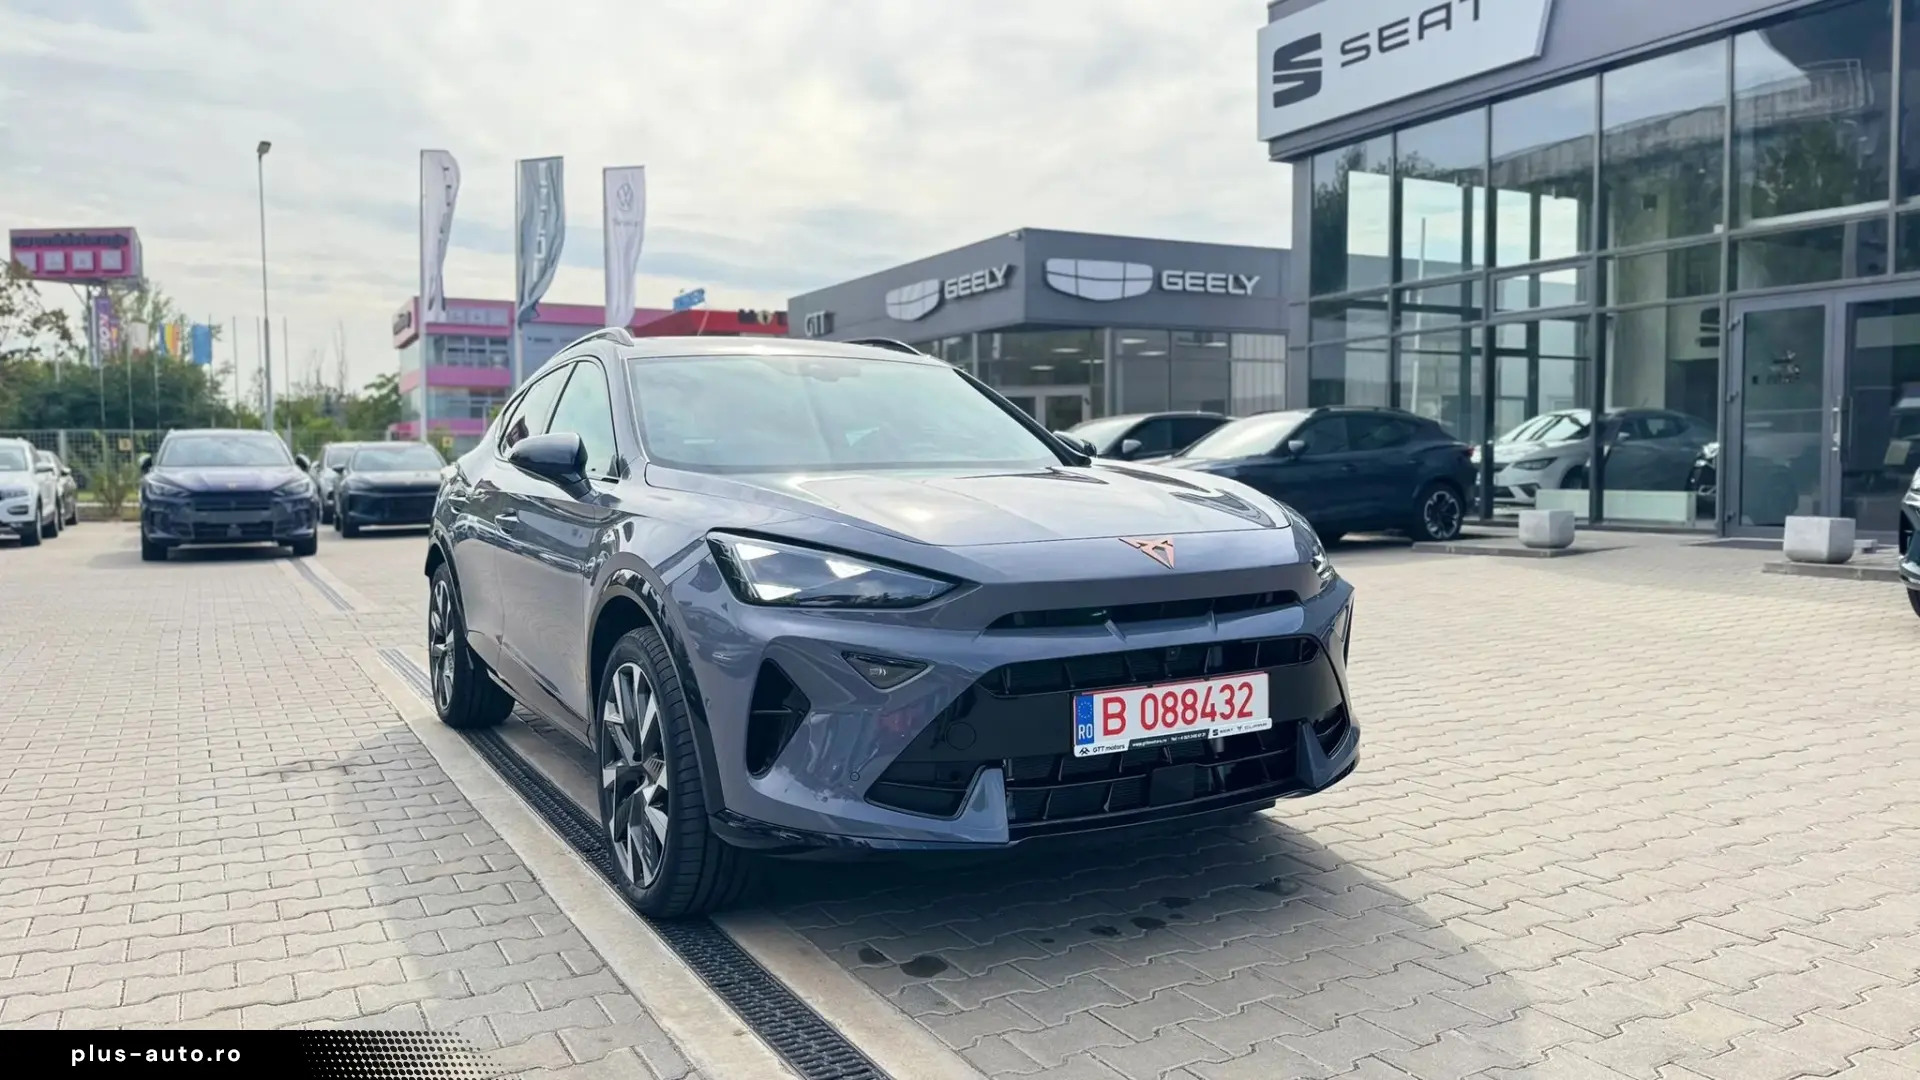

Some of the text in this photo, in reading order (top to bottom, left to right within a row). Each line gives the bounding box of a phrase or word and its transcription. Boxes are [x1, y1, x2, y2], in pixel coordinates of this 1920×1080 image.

[1340, 0, 1480, 68] SEAT
[943, 263, 1010, 300] GEELY
[1160, 269, 1261, 296] GEELY
[1102, 681, 1253, 736] B 088432
[1078, 723, 1093, 740] RO
[1092, 743, 1126, 753] GTT motors
